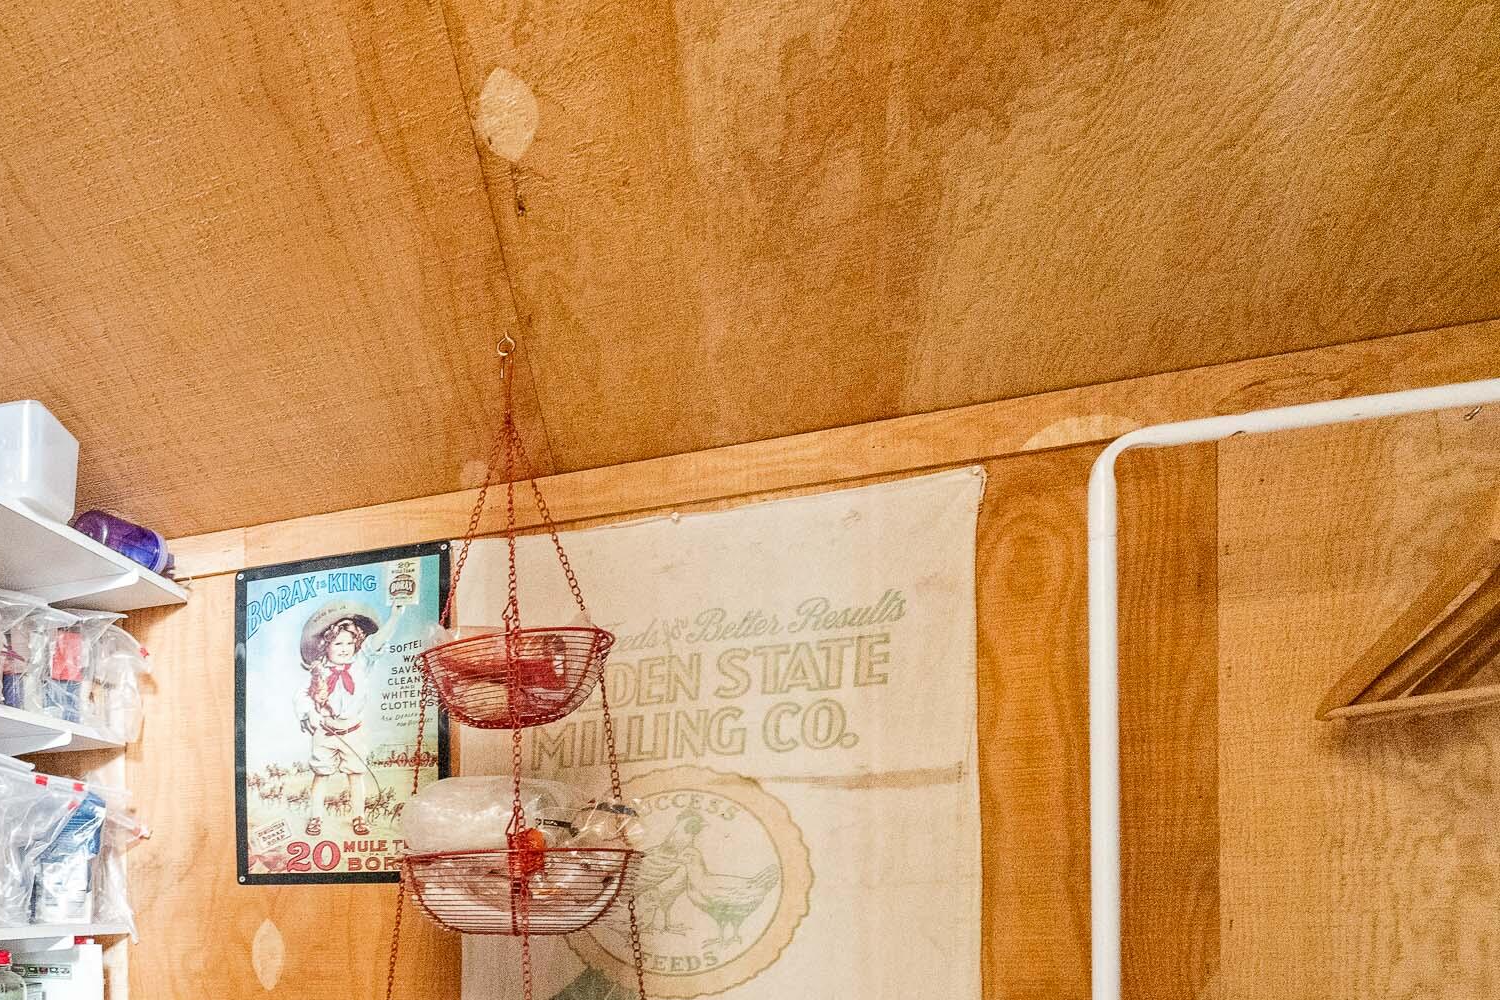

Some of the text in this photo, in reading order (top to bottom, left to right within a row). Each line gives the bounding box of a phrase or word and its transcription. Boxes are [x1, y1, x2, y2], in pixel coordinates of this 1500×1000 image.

[246, 575, 316, 641] BORAX
[328, 572, 378, 594] KING
[685, 606, 785, 643] Better
[389, 640, 423, 653] SOFTE
[387, 676, 421, 686] CLEAN
[391, 665, 421, 675] SAVE
[588, 632, 893, 711] DEN STATE
[531, 697, 860, 771] MILLING CO.
[286, 841, 341, 872] 20
[343, 840, 388, 853] MULE
[348, 855, 395, 871] BOR
